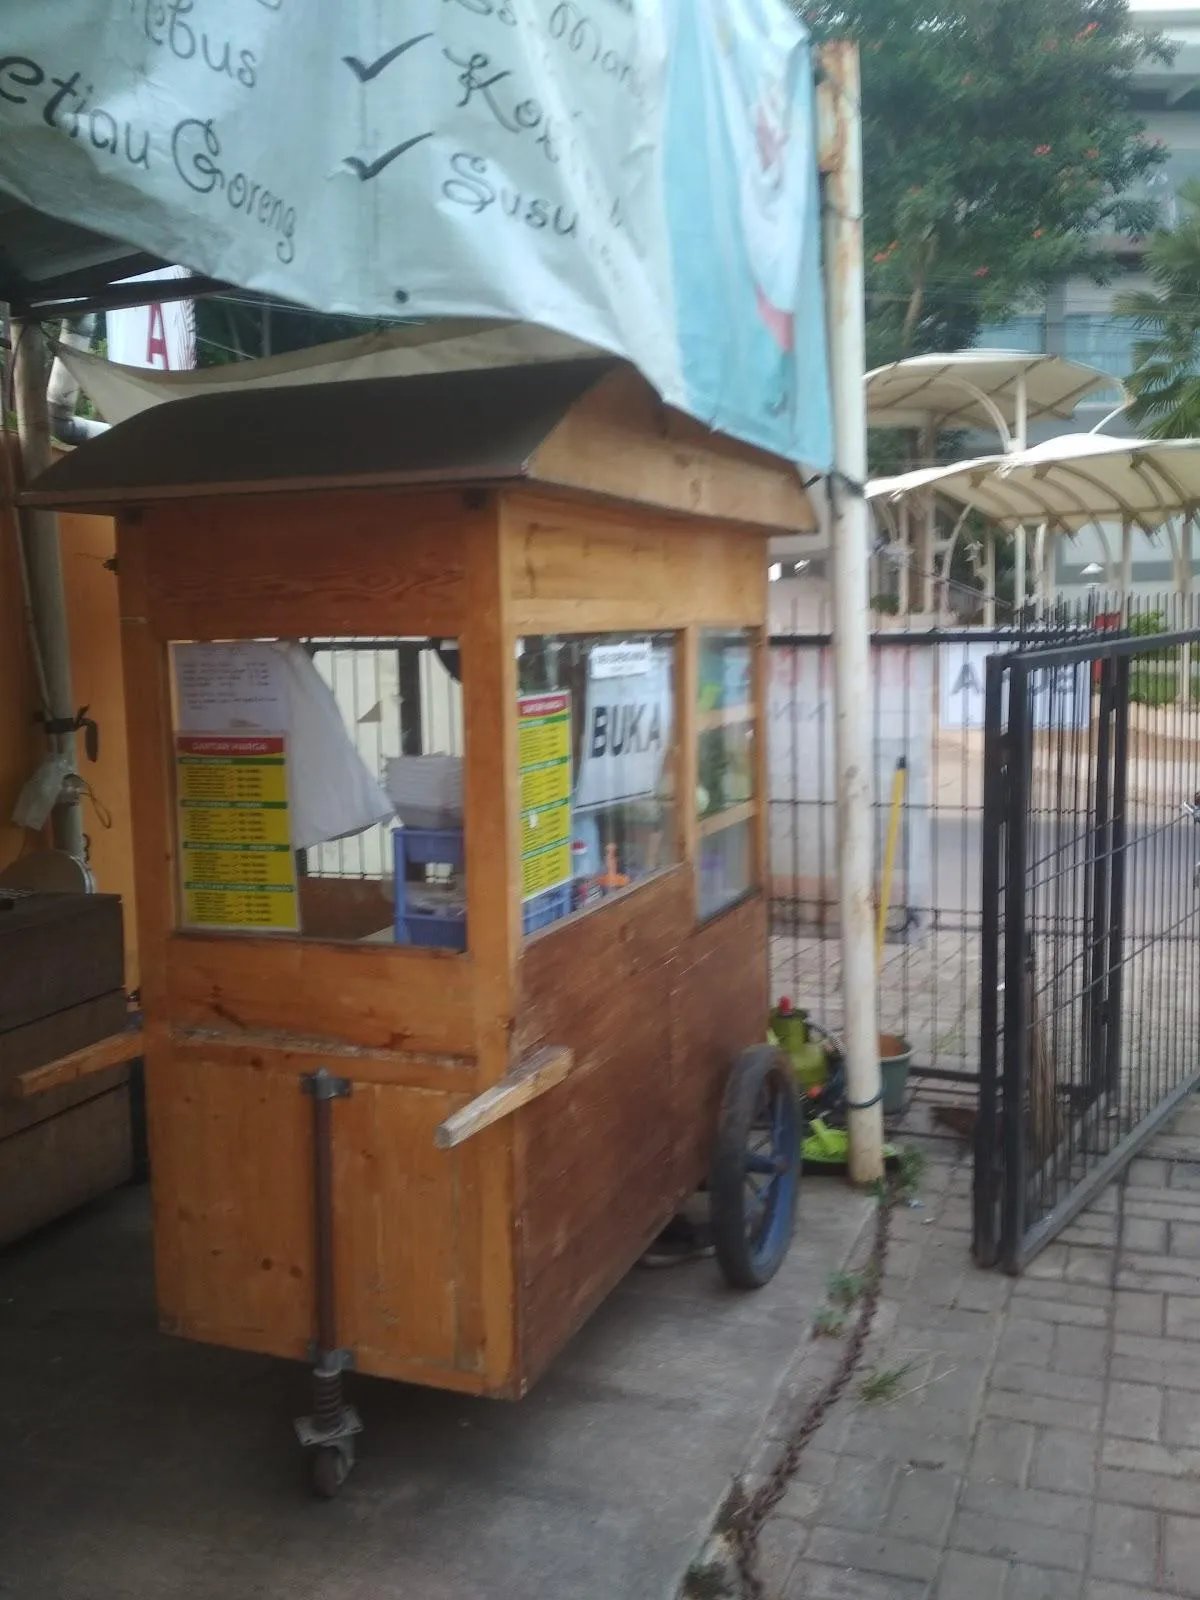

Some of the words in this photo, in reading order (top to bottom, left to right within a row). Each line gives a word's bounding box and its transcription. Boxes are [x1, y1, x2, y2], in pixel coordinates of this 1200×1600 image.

[171, 117, 299, 264] Goreng
[441, 152, 579, 239] Susu
[589, 701, 663, 759] BUKA
